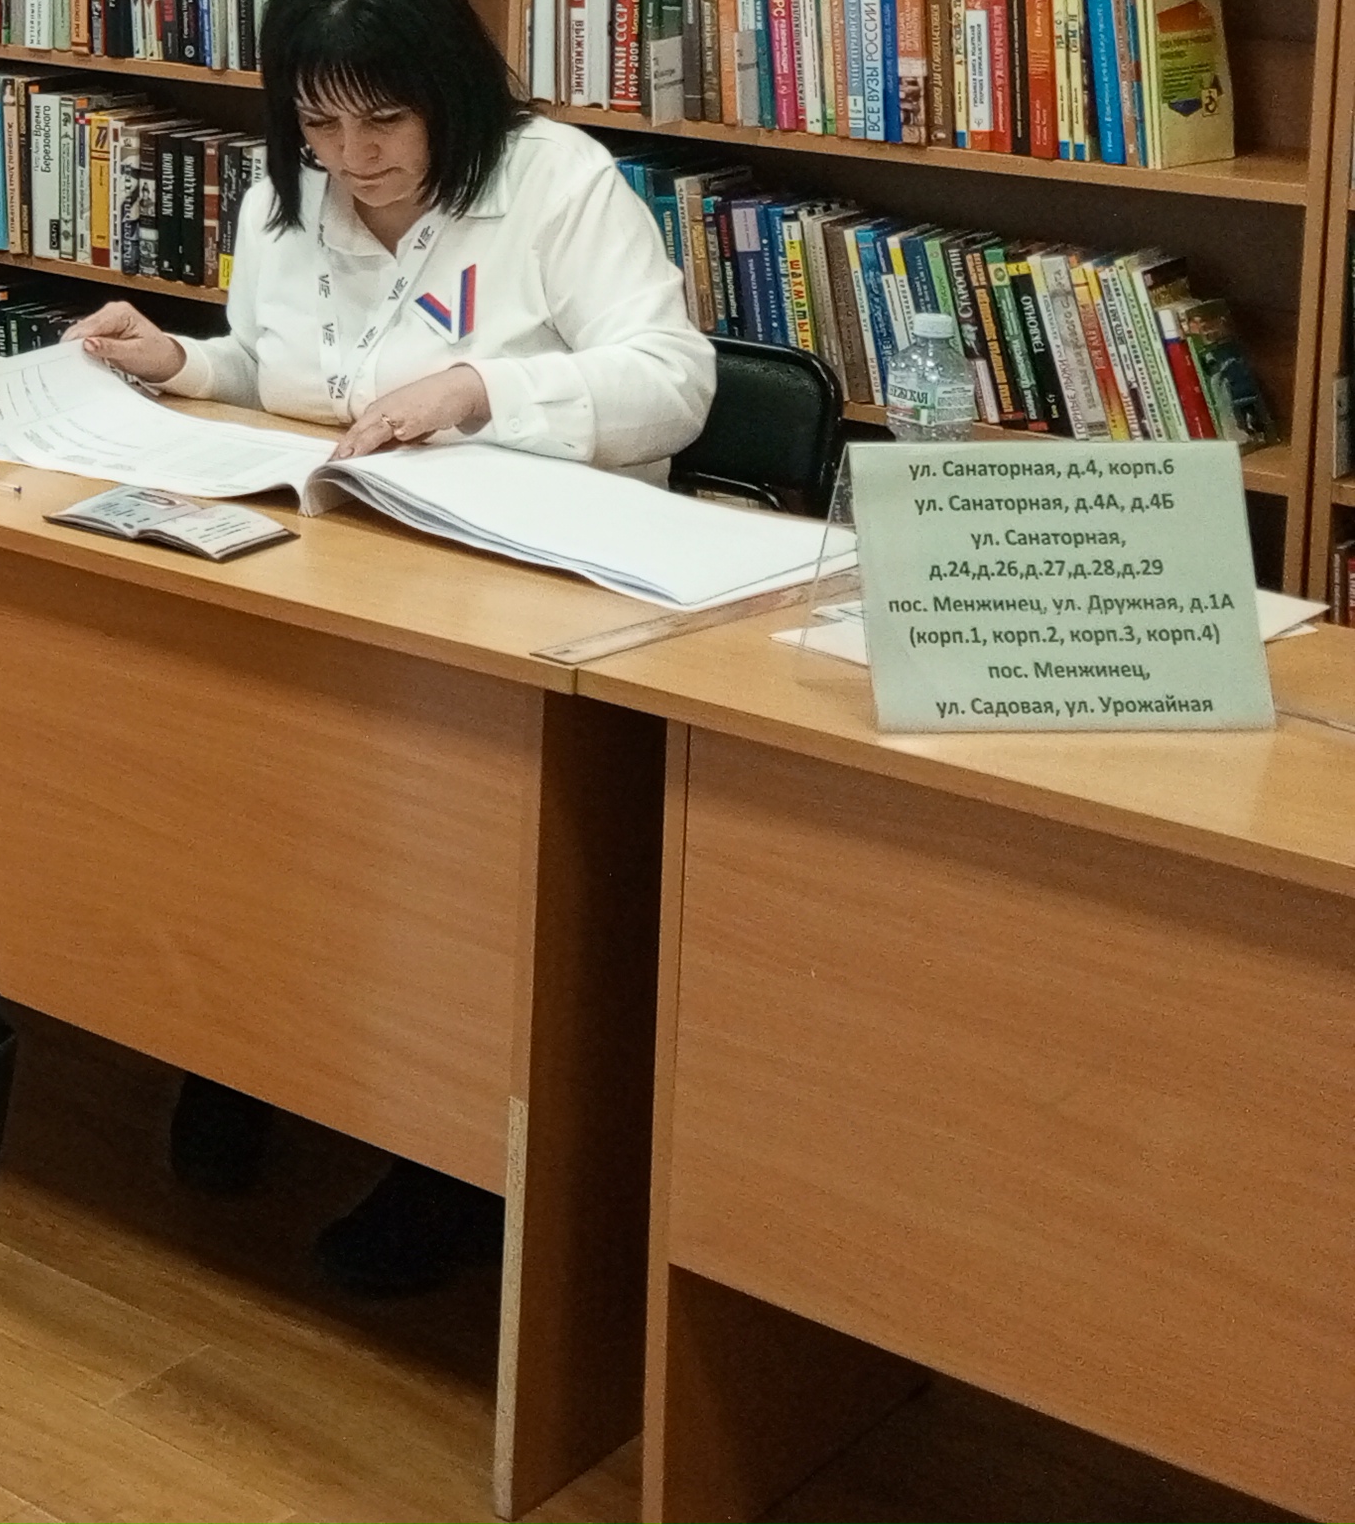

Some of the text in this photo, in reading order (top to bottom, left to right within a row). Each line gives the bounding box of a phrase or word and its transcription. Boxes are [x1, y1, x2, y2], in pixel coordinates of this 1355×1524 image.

[614, 4, 627, 42] СССР
[865, 2, 879, 62] РОССИИ
[574, 20, 585, 95] ВЫЖИВАНИЕ
[614, 46, 627, 96] ТАНКИ
[866, 66, 880, 102] ВУЗЫ
[34, 105, 45, 137] Время
[866, 107, 881, 132] ВСЕ
[41, 105, 53, 173] Березовского
[789, 260, 810, 333] ШАХМАТЫ
[1021, 295, 1045, 354] ТЭКВОНДО
[1058, 359, 1076, 391] ЛЫЖИ
[909, 459, 1175, 482] ул. Санаторная, д.4, корп.6
[915, 494, 1174, 516] ул. Санаторная, д.4А, д.4Б
[971, 529, 1126, 550] ул. Санаторная,
[928, 559, 1164, 582] д.24,д.26,д.27,д.28,д.29
[889, 594, 1235, 617] пос. Менжинец, ул. Дружная, д.1А
[908, 625, 1221, 647] (корп.1, корп.2, корп.3, корп.4)
[988, 661, 1151, 683] пос. Менжинец,
[936, 694, 1213, 719] ул. Садовая, ул. Урожайная
